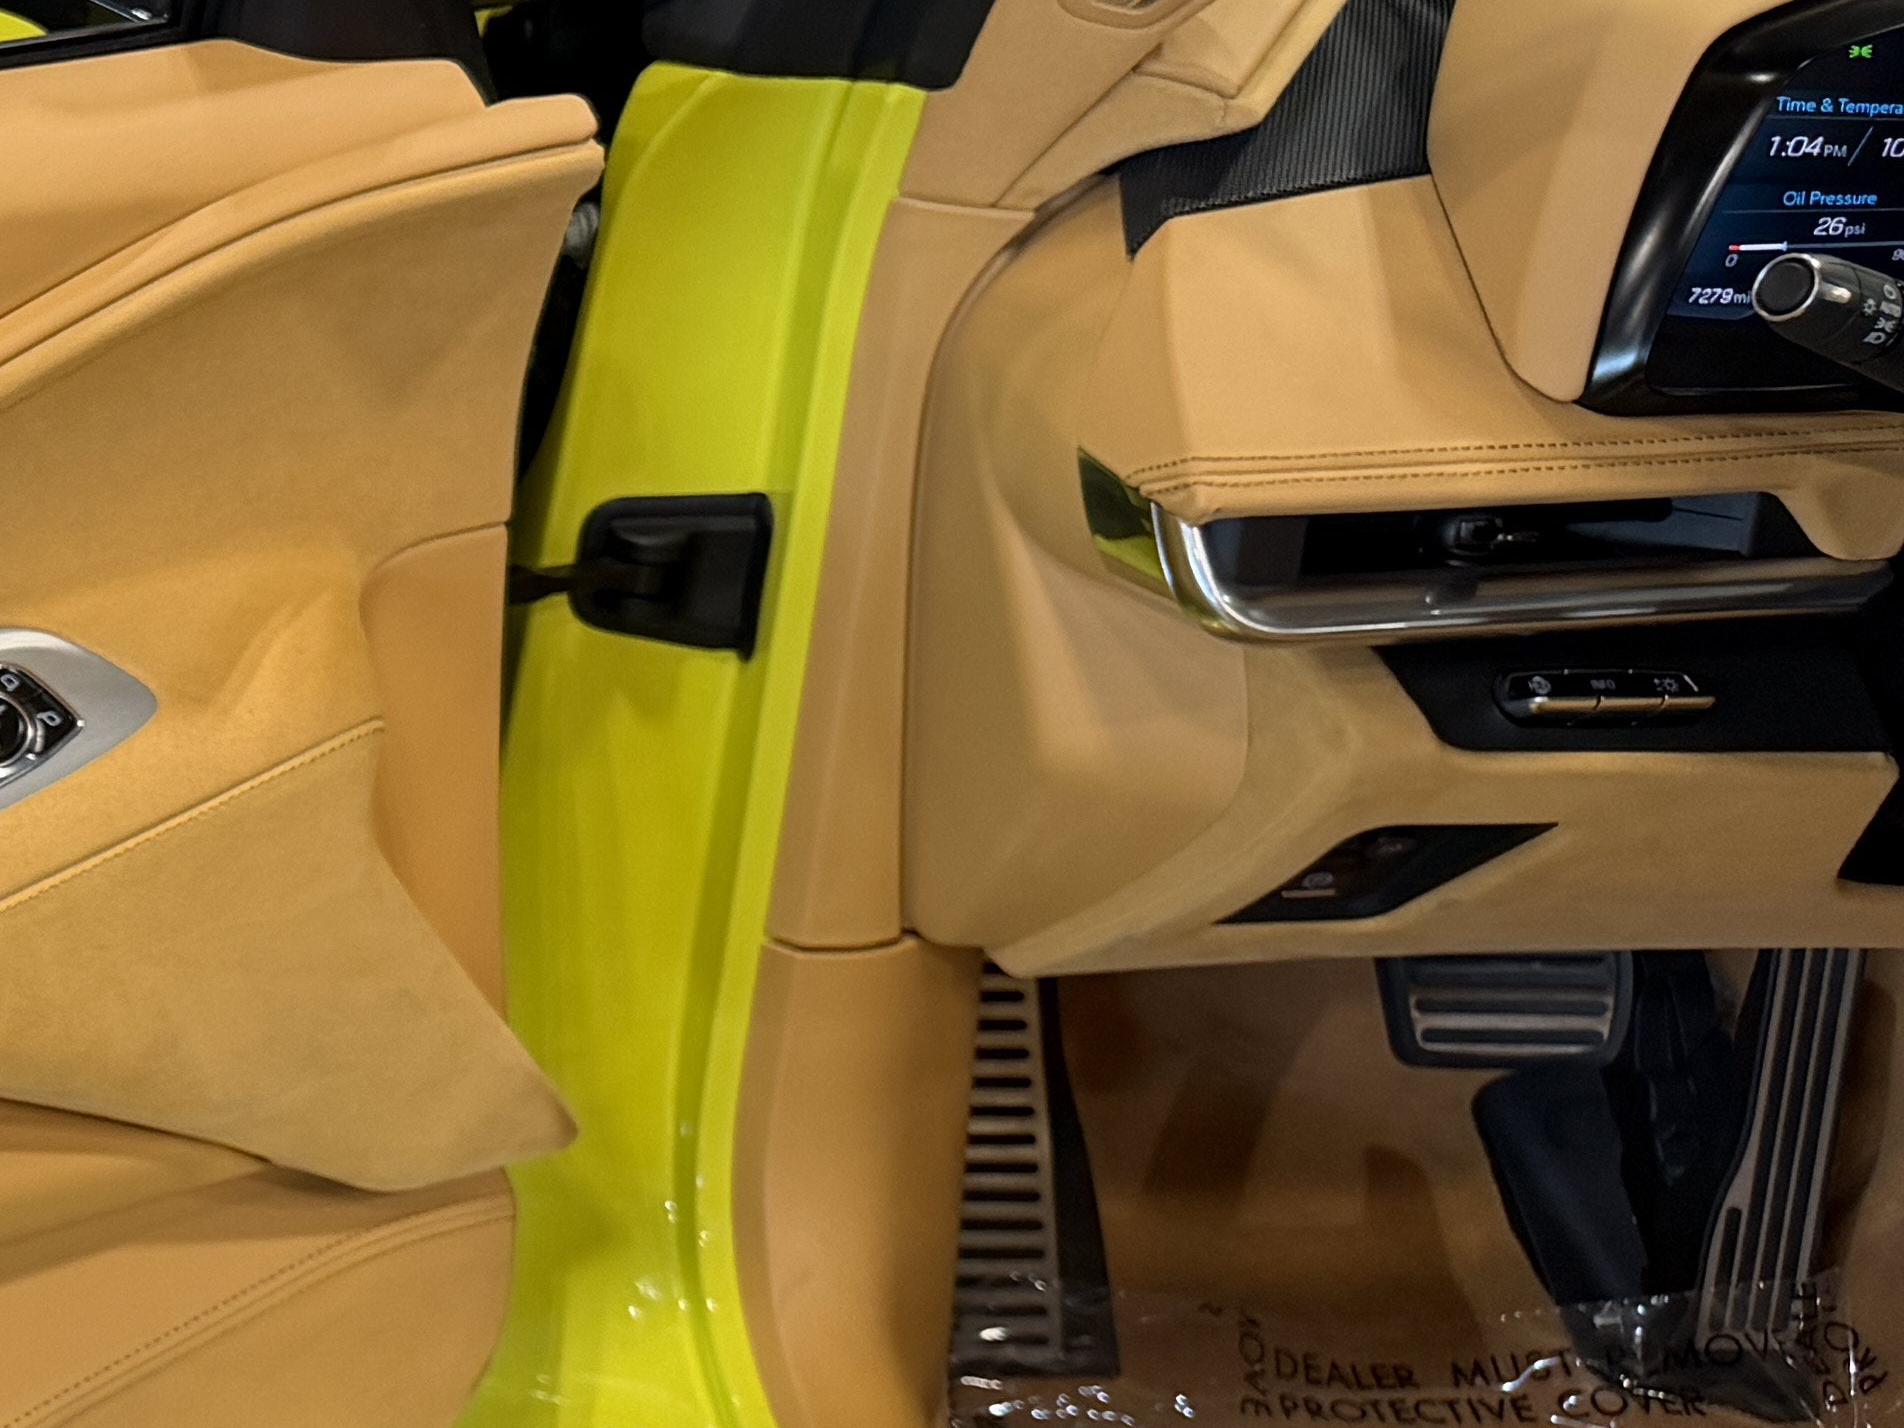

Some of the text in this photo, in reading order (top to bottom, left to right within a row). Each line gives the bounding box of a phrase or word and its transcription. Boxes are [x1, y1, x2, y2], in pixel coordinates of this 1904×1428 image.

[1776, 95, 1817, 113] Time
[1820, 97, 1834, 113] &
[1783, 191, 1878, 206] Oil Pressure
[1725, 253, 1739, 268] 0
[1272, 1344, 1420, 1391] DEALER
[1277, 1386, 1707, 1426] PROTECTIVE COVER
